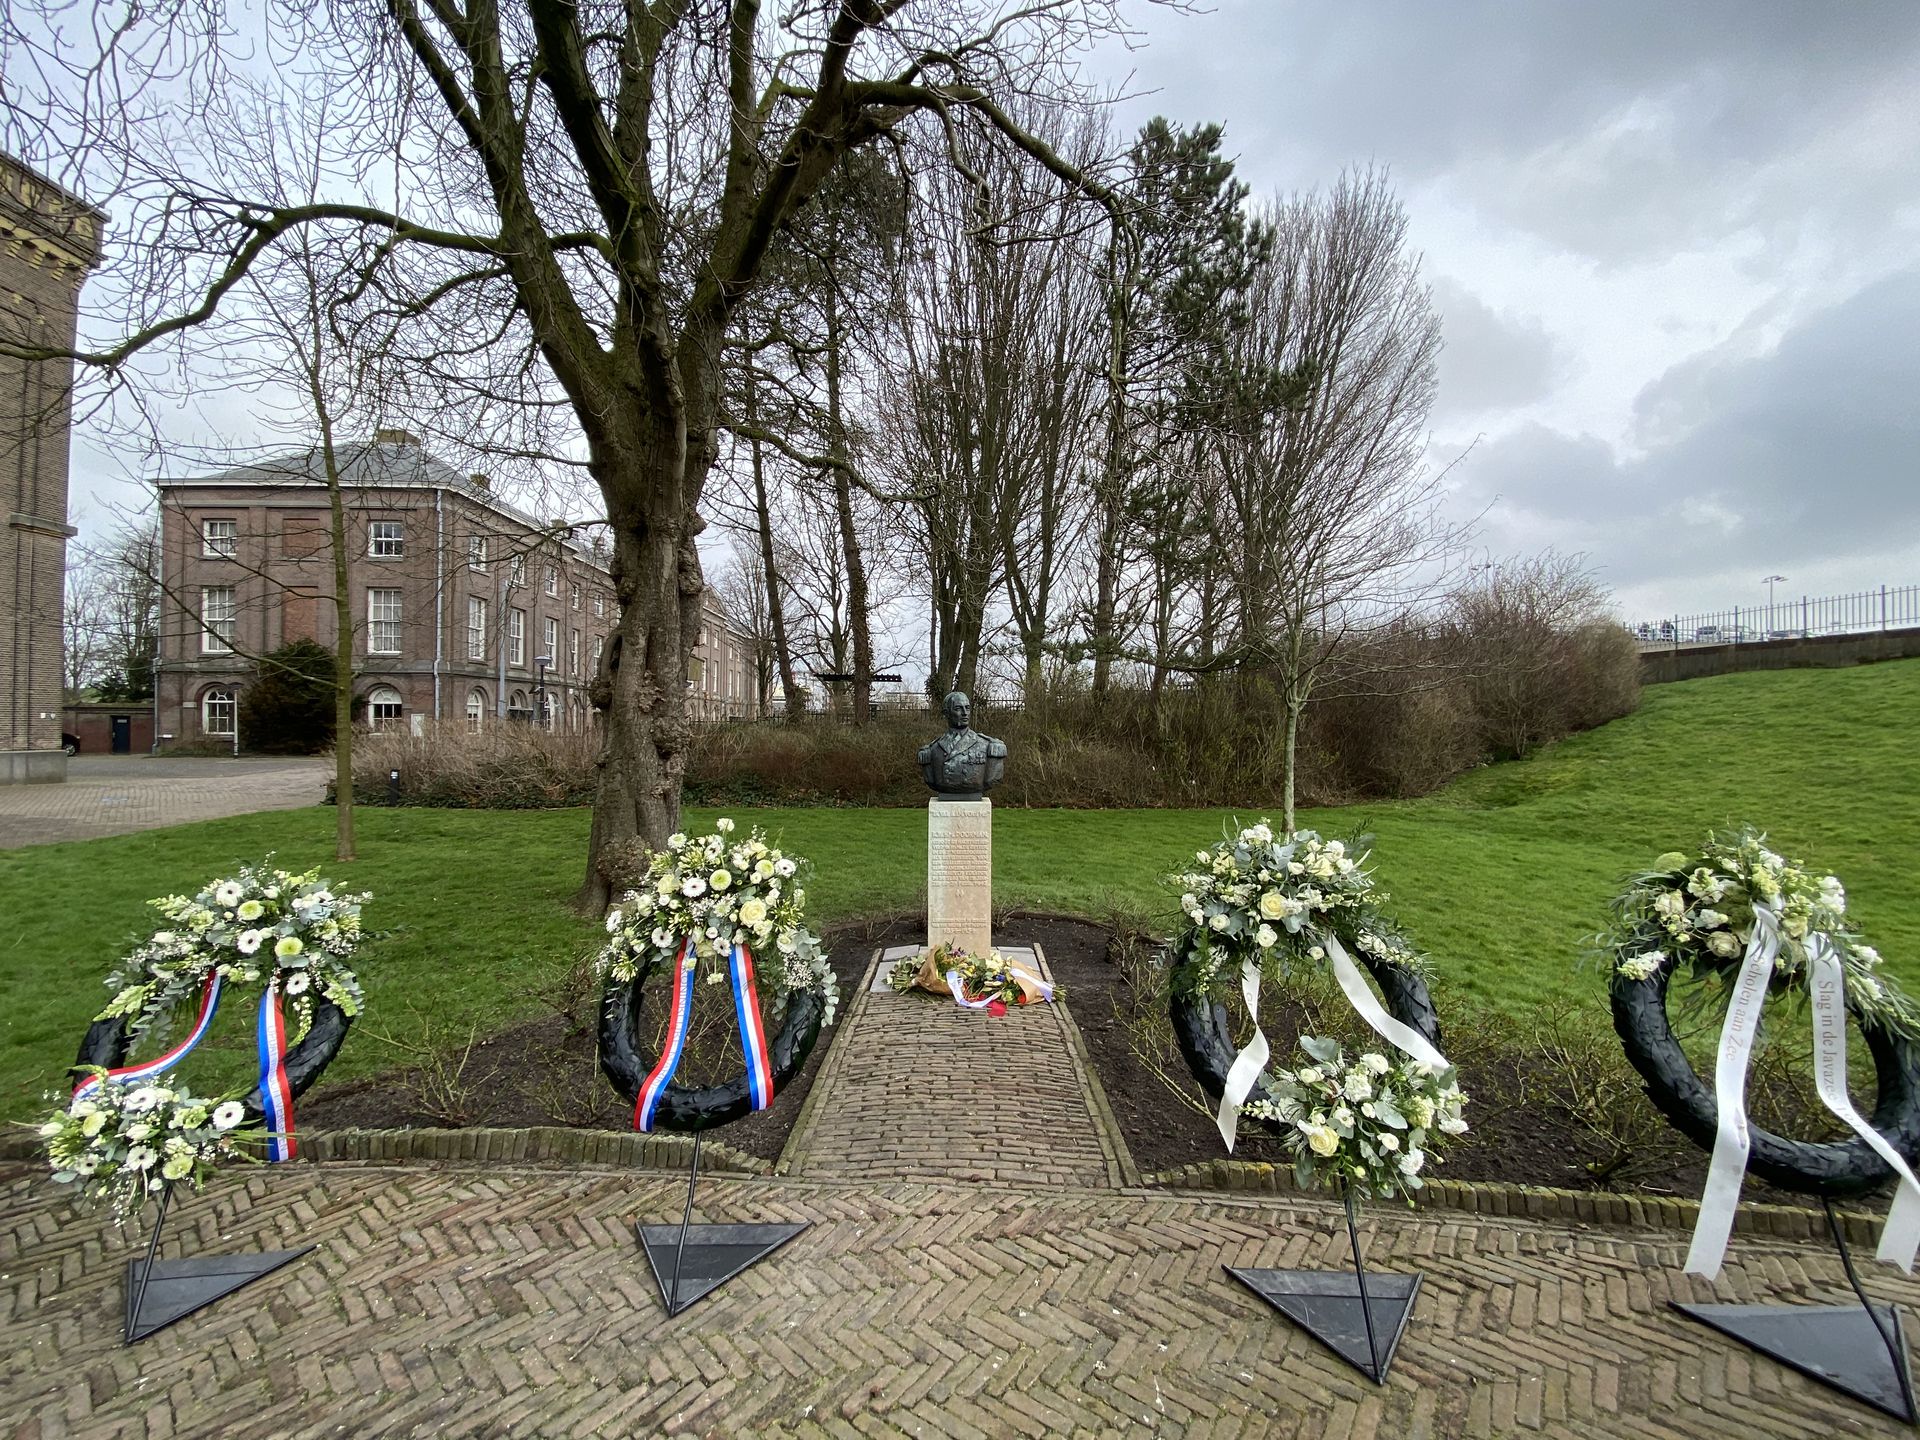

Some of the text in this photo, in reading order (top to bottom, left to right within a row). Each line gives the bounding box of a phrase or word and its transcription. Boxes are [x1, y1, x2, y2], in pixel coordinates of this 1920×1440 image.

[1816, 980, 1834, 1010] Slag
[1731, 1008, 1747, 1033] aan
[1821, 1014, 1838, 1027] in
[1725, 1035, 1744, 1061] Zee
[1822, 1030, 1838, 1047] de
[1822, 1048, 1838, 1101] Javazee
[275, 1102, 288, 1153] VERGEEN
